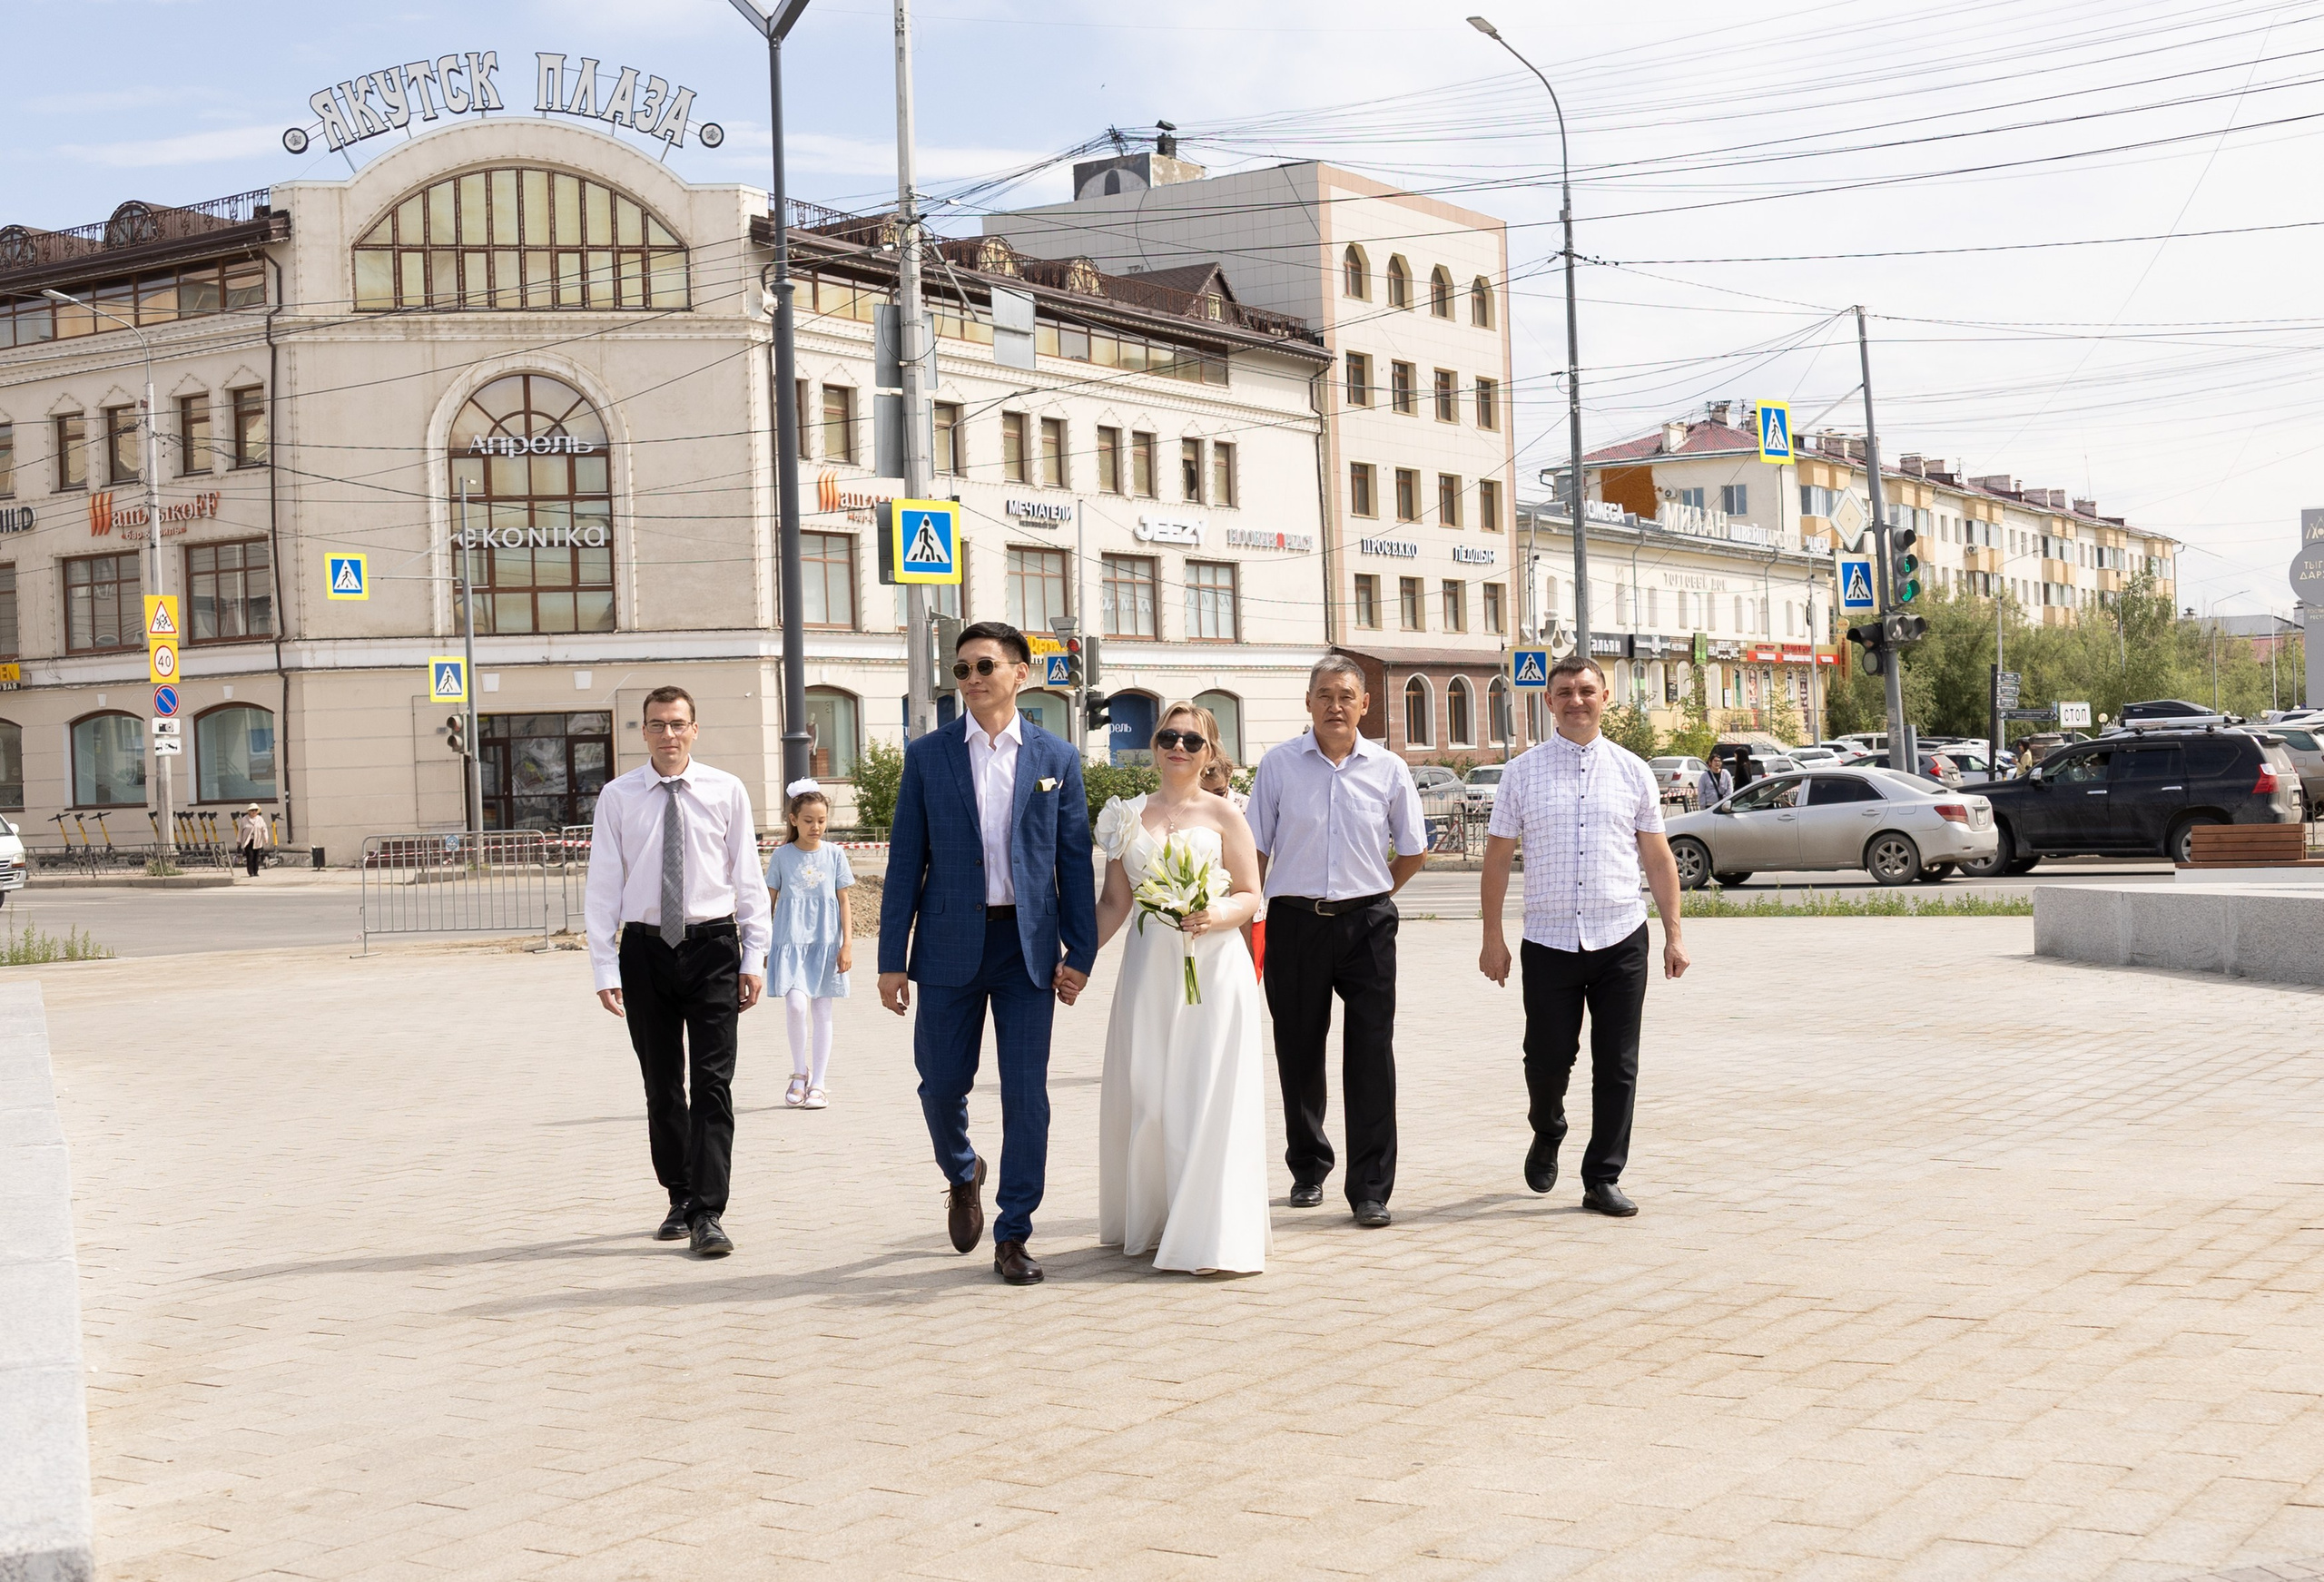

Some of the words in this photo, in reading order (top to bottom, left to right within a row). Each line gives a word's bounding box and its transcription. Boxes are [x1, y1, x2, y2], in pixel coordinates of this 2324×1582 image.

[310, 51, 504, 152] ЯКУТСК
[535, 52, 697, 149] ПЛАЗА
[468, 435, 595, 458] Апрель
[1007, 500, 1072, 520] МЕЧТАТЕЛИ
[1588, 500, 1626, 523] OMEGA
[1662, 501, 1728, 539] МИЛАН
[125, 529, 142, 540] бар
[1134, 515, 1209, 545] JEEZY
[1362, 538, 1418, 557] ПРОСЕККО
[2304, 560, 2324, 570] ТЫГ
[2299, 571, 2324, 580] ДАР
[1589, 635, 1621, 653] альян
[158, 655, 172, 668] 40
[2063, 708, 2087, 722] СТОП
